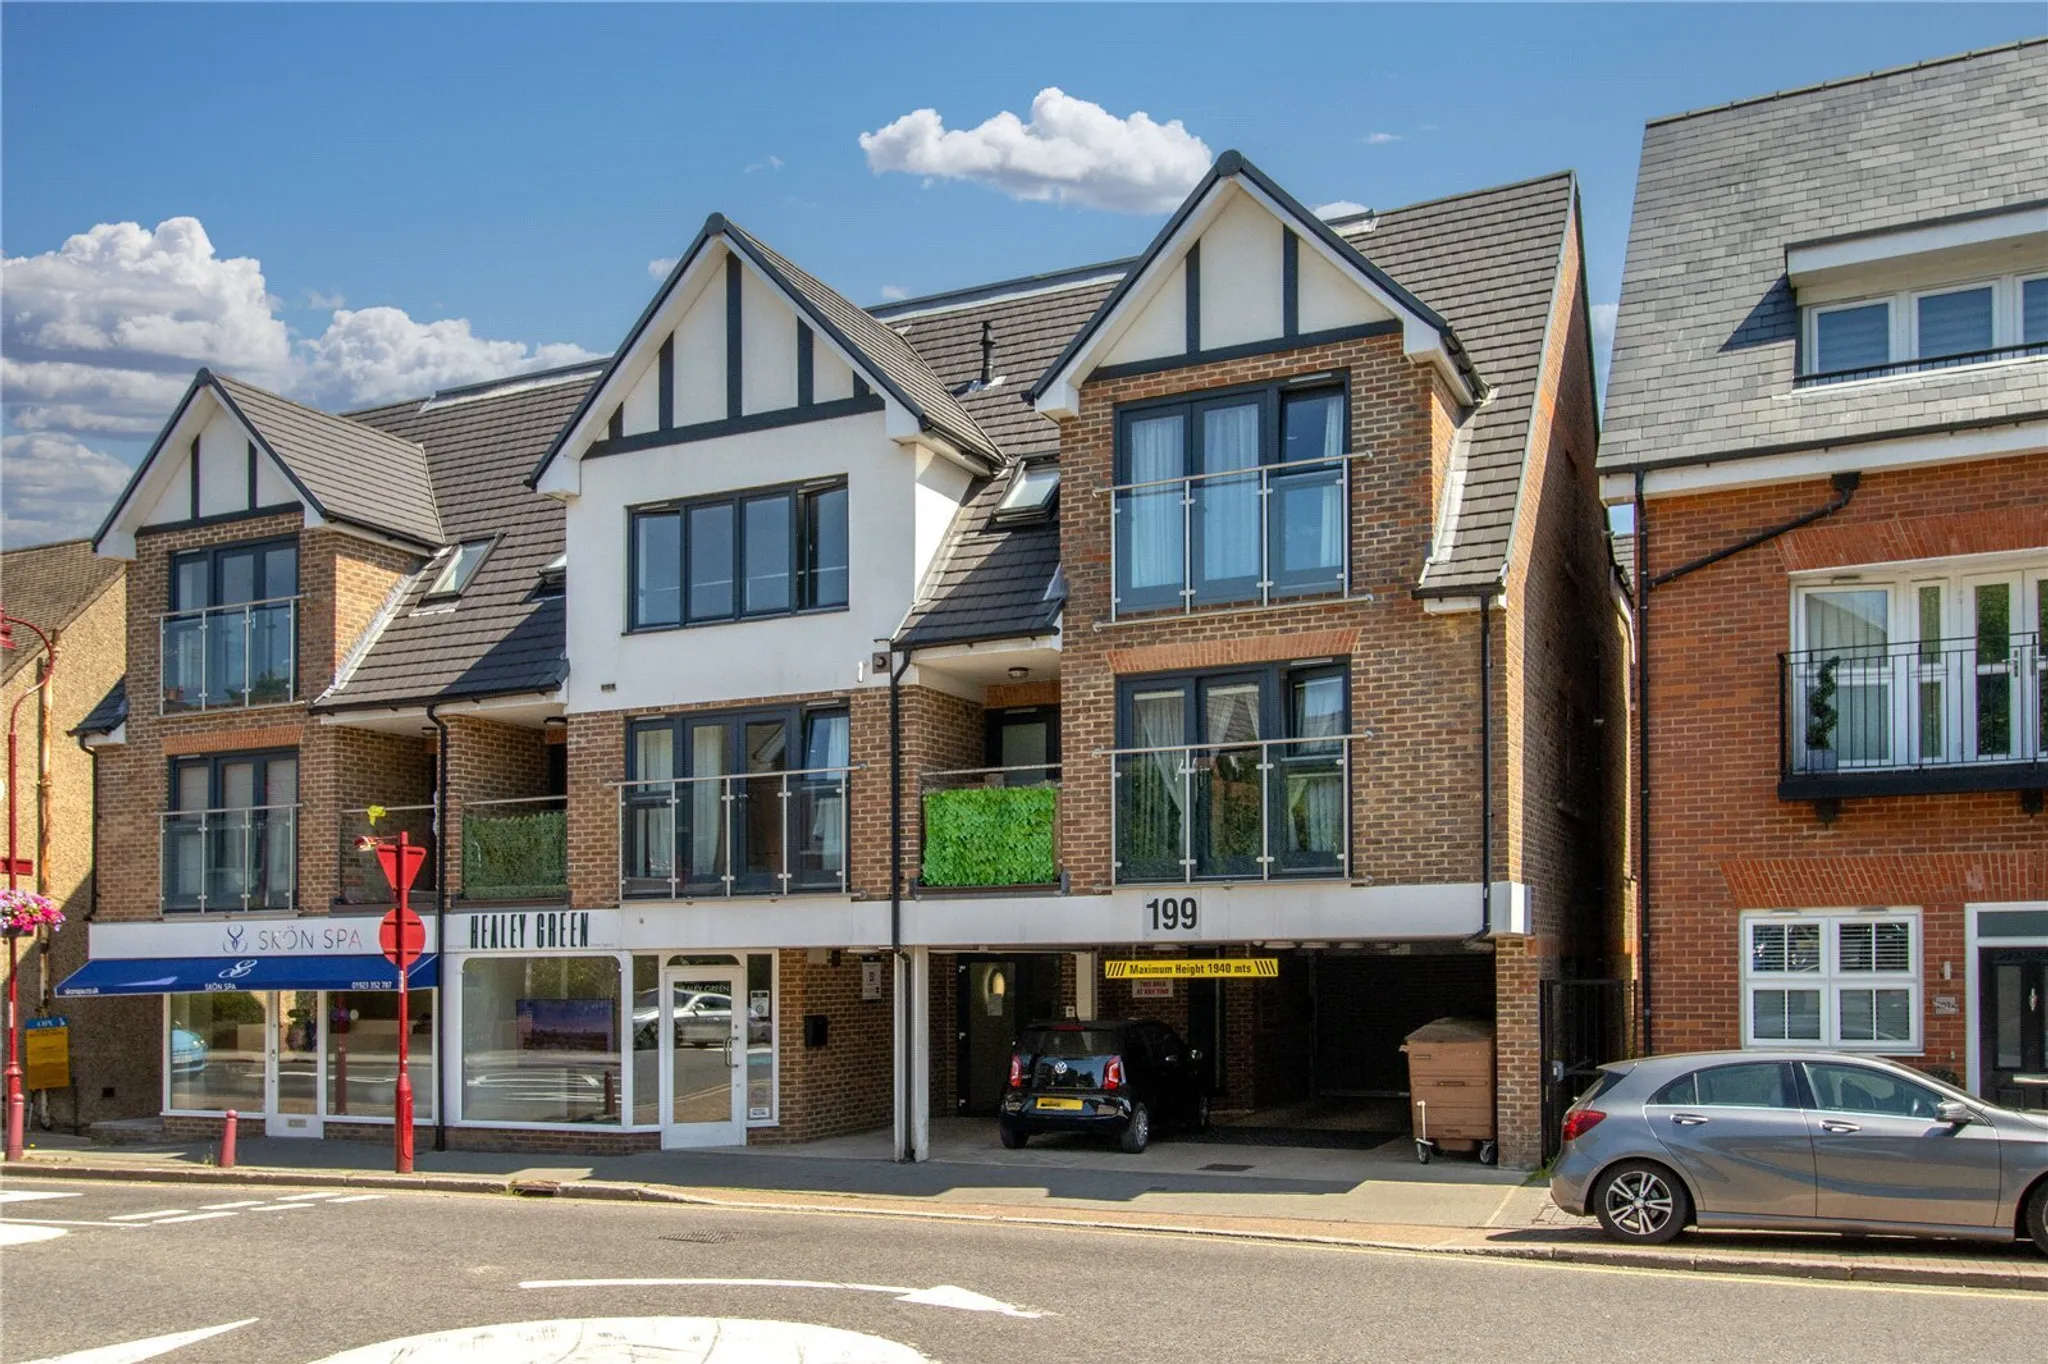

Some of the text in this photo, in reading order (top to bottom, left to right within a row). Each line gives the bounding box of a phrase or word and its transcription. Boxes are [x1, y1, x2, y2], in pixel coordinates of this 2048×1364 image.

[1146, 897, 1197, 930] 199
[258, 925, 362, 950] SKÖN SPA
[470, 911, 589, 949] HEALEY GREEN
[1129, 964, 1173, 975] Maximum
[1175, 963, 1205, 976] Height
[1234, 964, 1252, 974] mts
